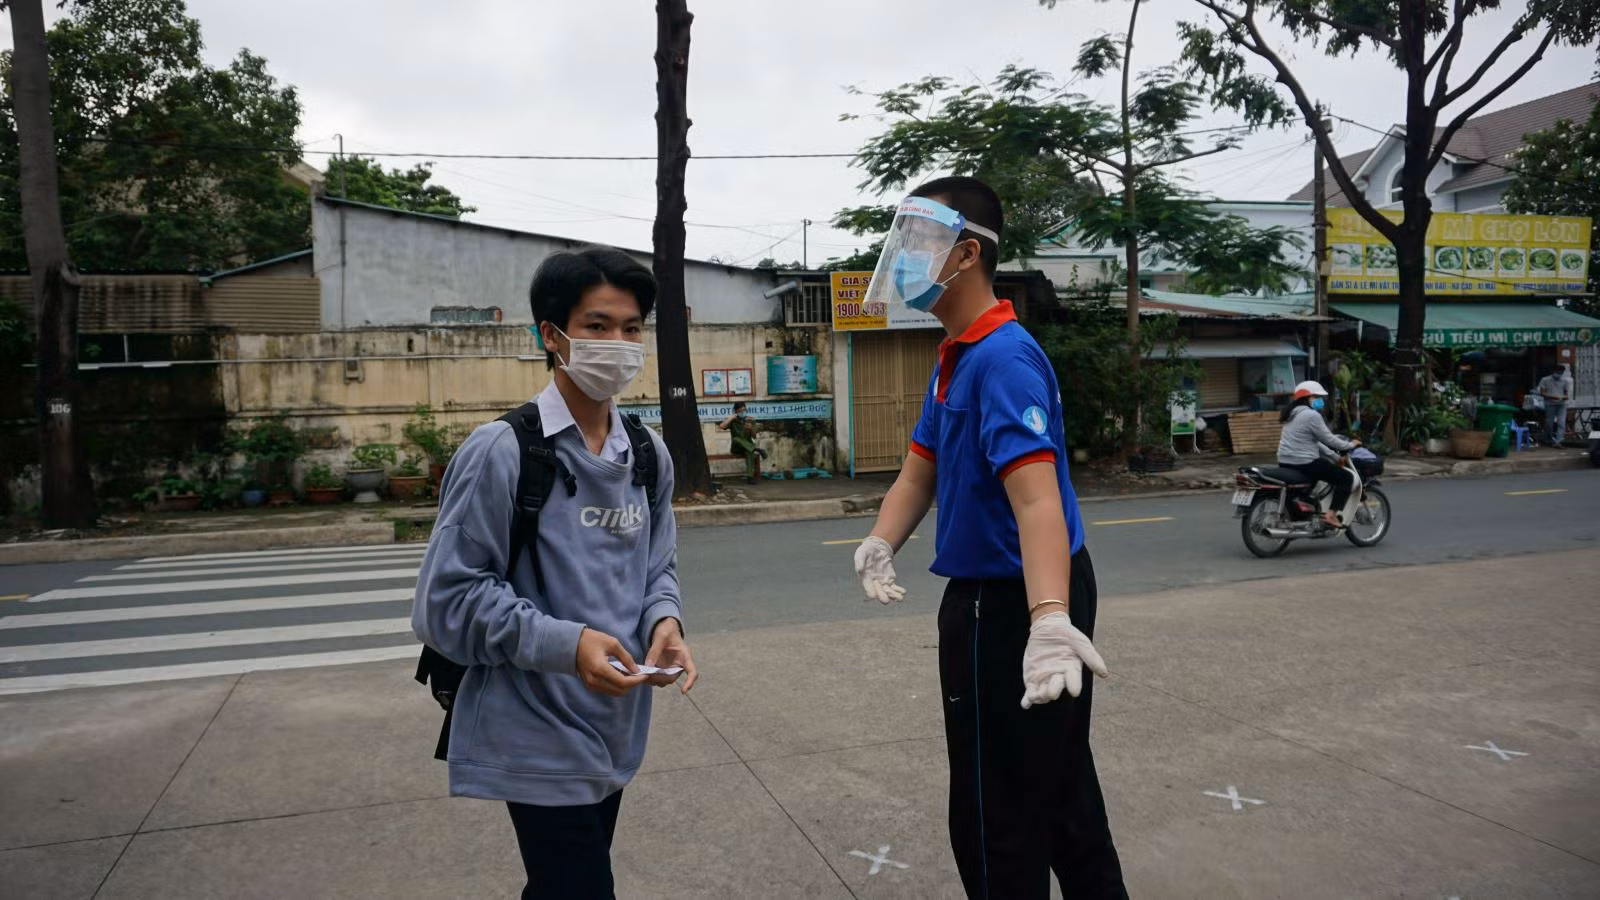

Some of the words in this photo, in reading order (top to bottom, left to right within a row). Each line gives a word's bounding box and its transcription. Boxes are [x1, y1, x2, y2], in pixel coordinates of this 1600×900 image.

[1442, 215, 1474, 241] MÌ
[1480, 219, 1530, 246] CHỢ
[841, 277, 860, 285] GIA
[837, 289, 860, 299] VIỆT
[836, 302, 860, 316] 1900
[1450, 330, 1485, 344] TIẾU
[1488, 329, 1508, 344] MÌ
[1513, 331, 1542, 345] CHỢ
[672, 387, 687, 397] 104
[50, 403, 71, 414] 106
